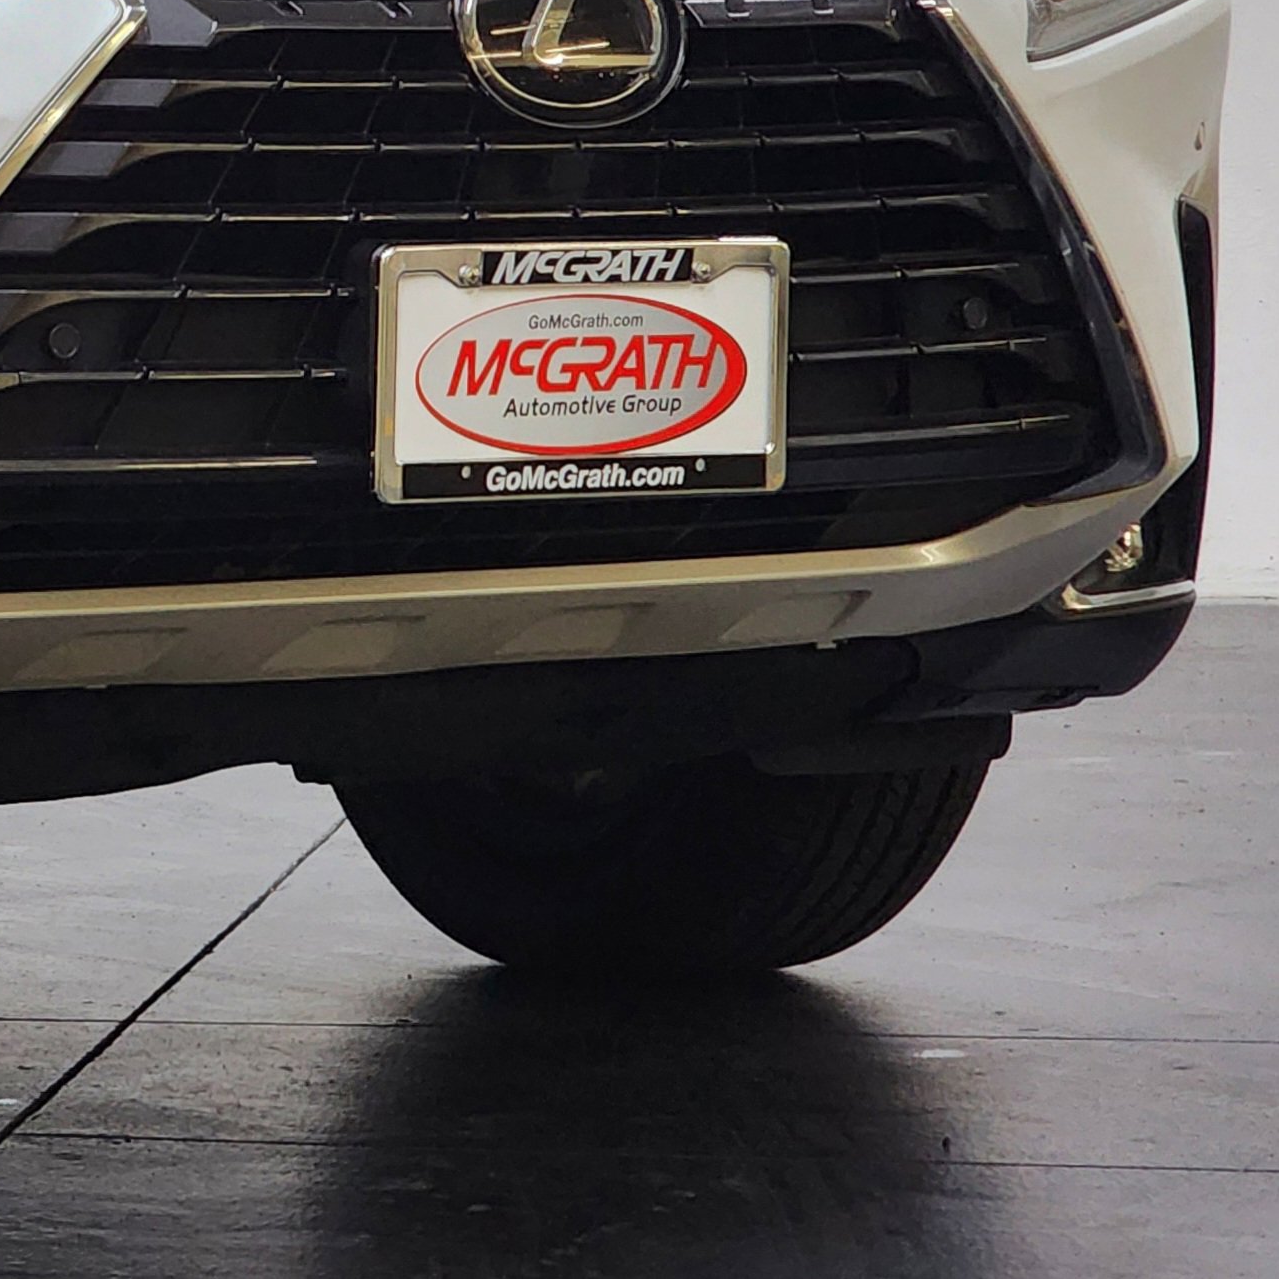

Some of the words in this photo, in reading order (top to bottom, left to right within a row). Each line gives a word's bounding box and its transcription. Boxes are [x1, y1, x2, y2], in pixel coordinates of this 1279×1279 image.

[528, 312, 644, 330] GoMcGrath.com
[503, 395, 616, 419] Automotive
[622, 394, 682, 416] Group
[486, 462, 685, 492] GoMcGrath.com
